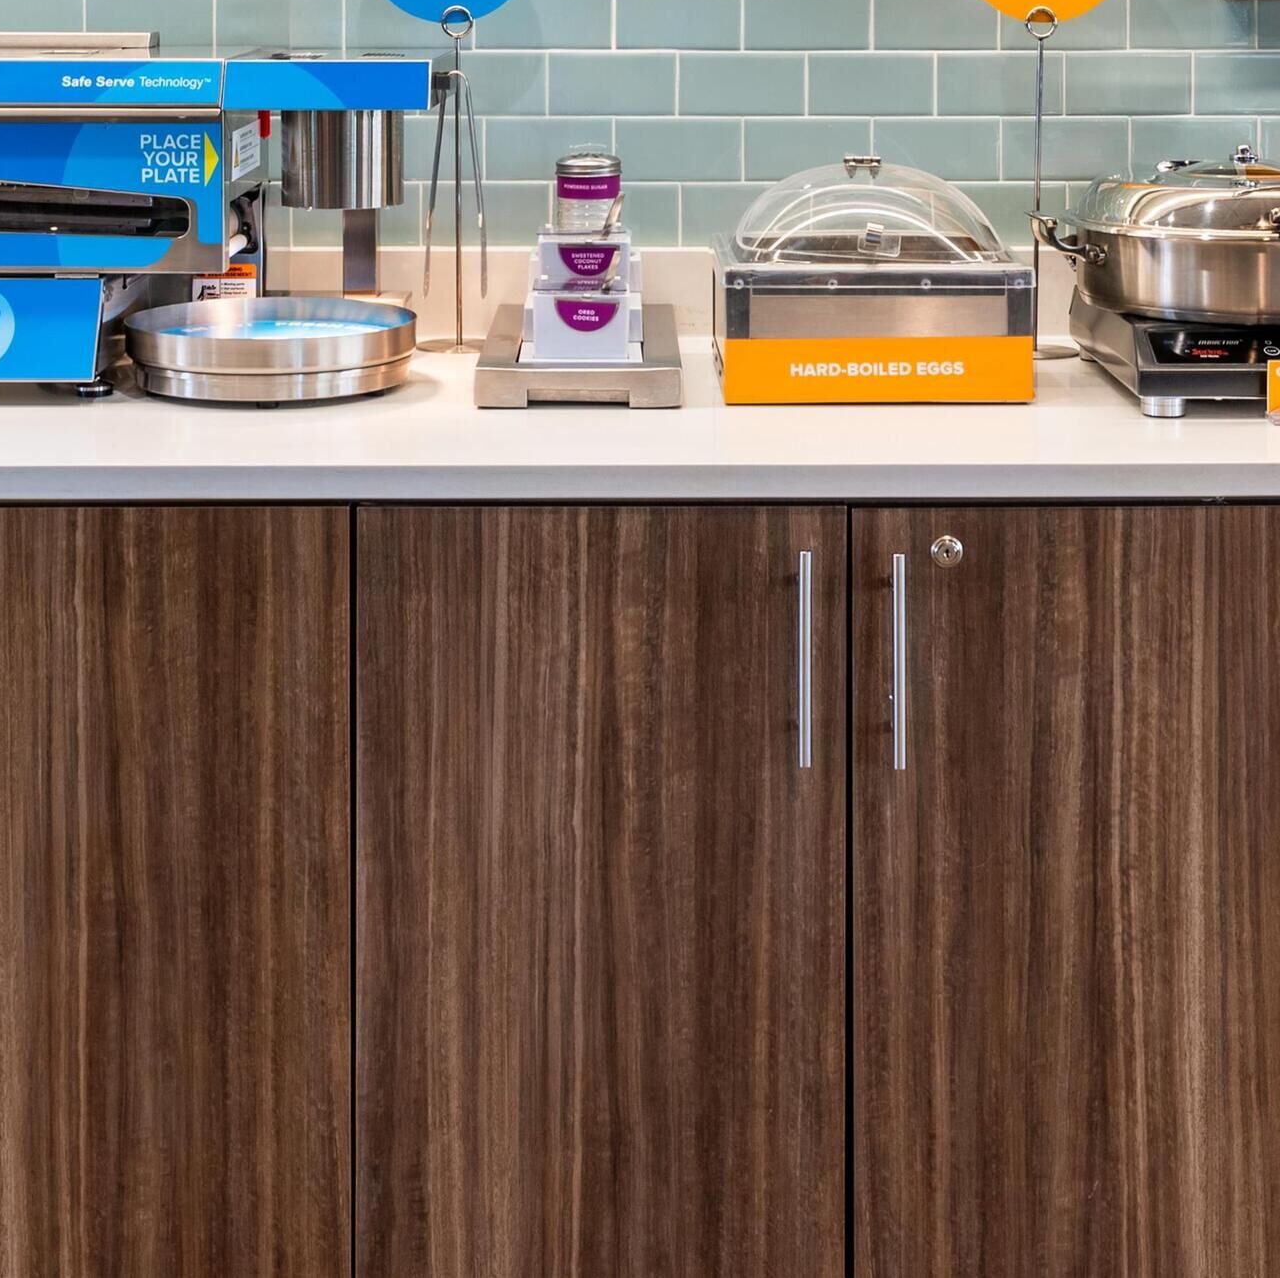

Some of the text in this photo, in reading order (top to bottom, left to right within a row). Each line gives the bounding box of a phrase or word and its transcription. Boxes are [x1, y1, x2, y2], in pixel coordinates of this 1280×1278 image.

[62, 75, 92, 88] Safe
[96, 75, 135, 88] Serve
[140, 134, 201, 149] PLACE
[143, 151, 198, 166] YOUR
[141, 168, 200, 183] PLATE
[790, 361, 964, 377] HARD-BOILED EGGS
